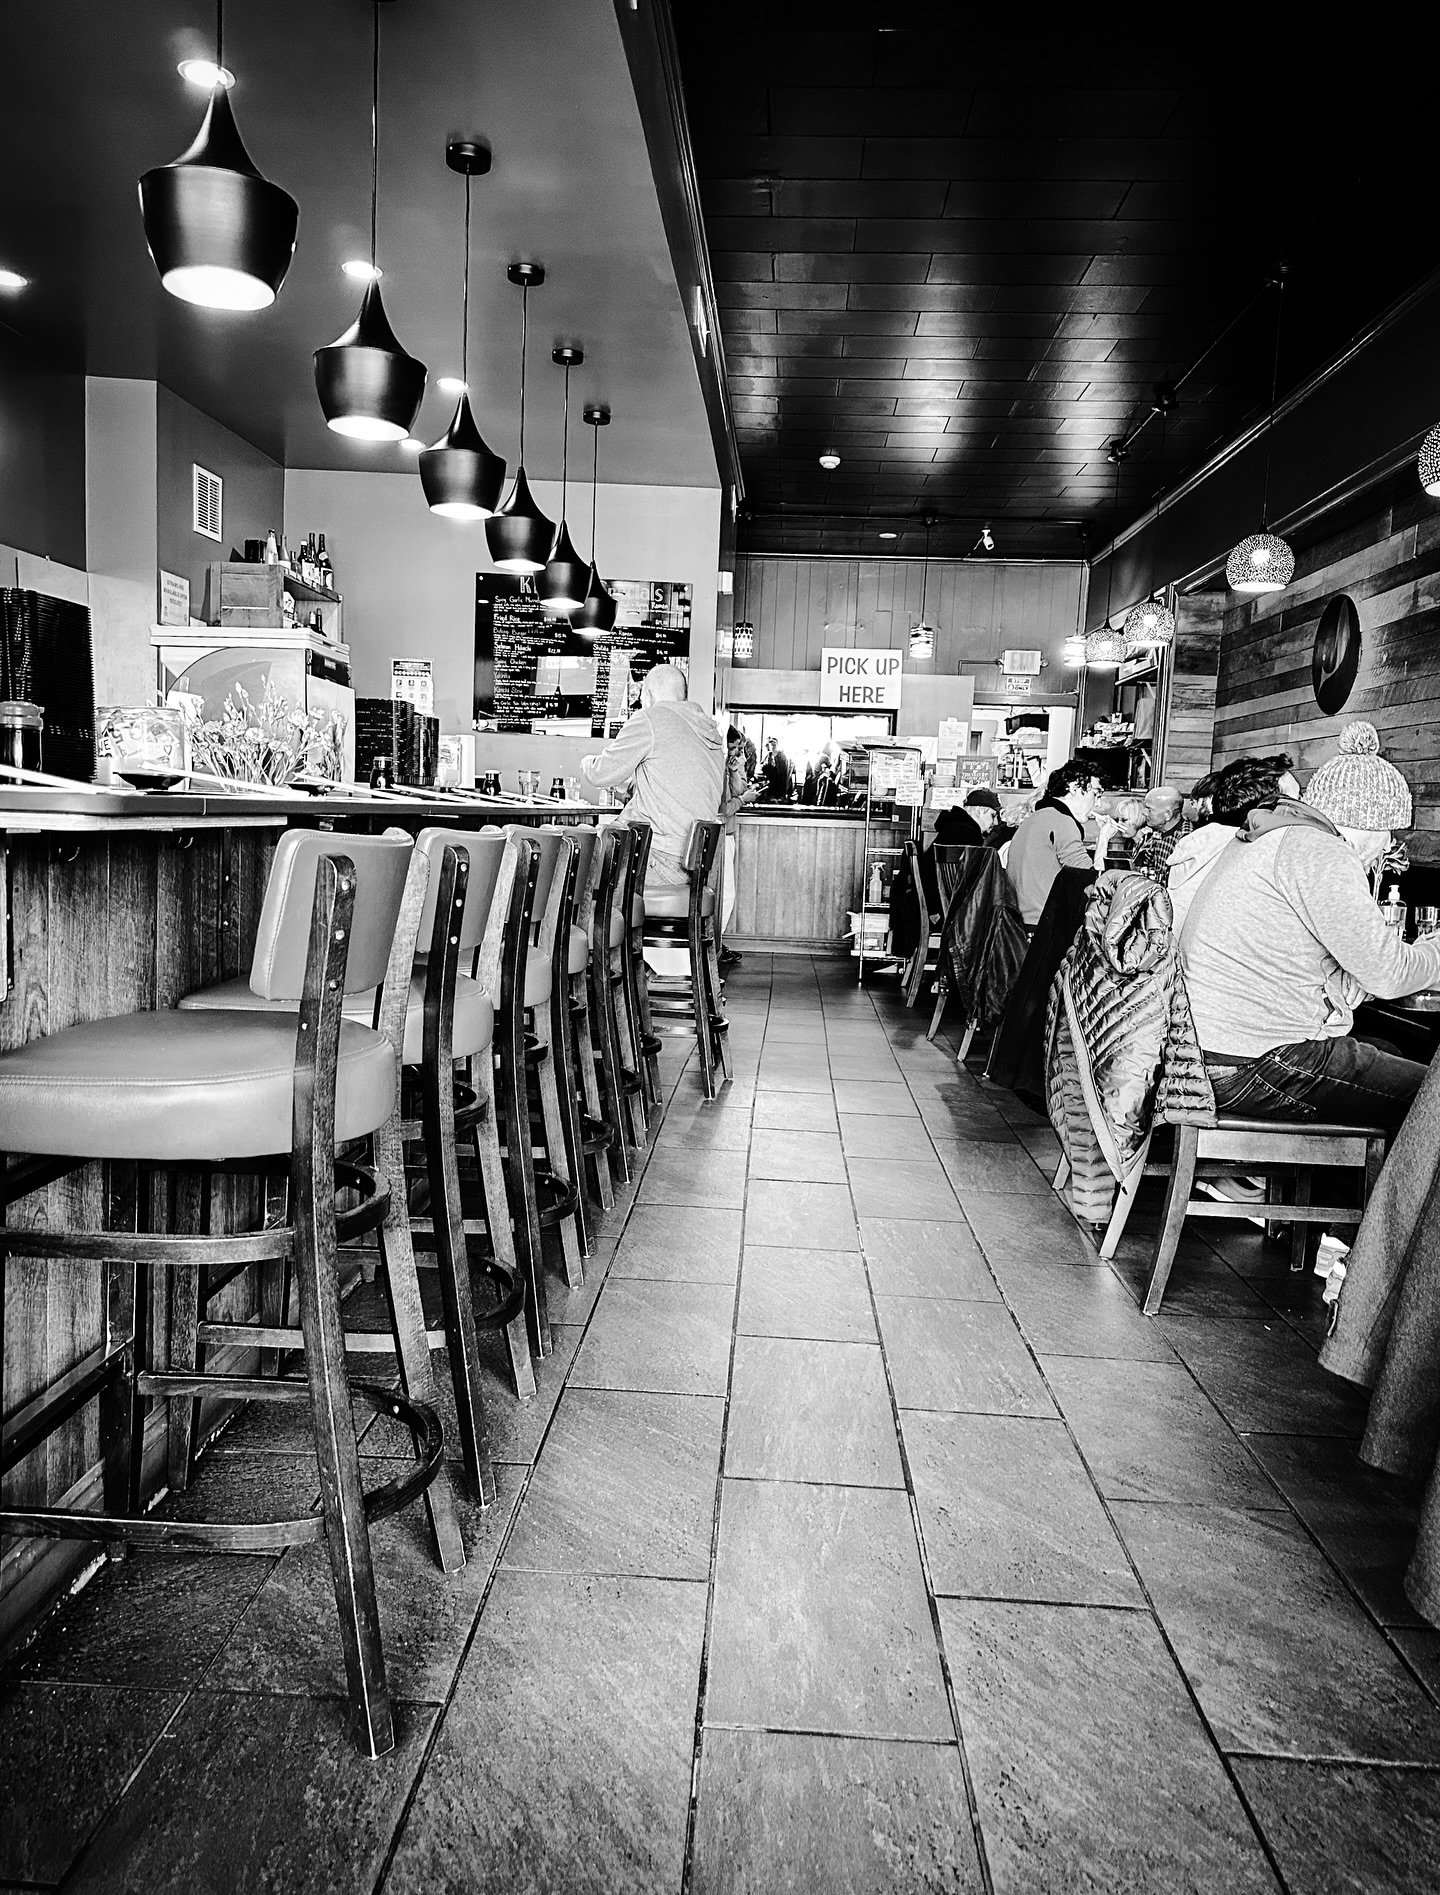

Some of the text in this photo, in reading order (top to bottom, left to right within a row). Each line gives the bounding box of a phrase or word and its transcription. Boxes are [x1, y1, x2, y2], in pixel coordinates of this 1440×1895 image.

[827, 656, 900, 675] PICK UP
[839, 685, 886, 703] HERE
